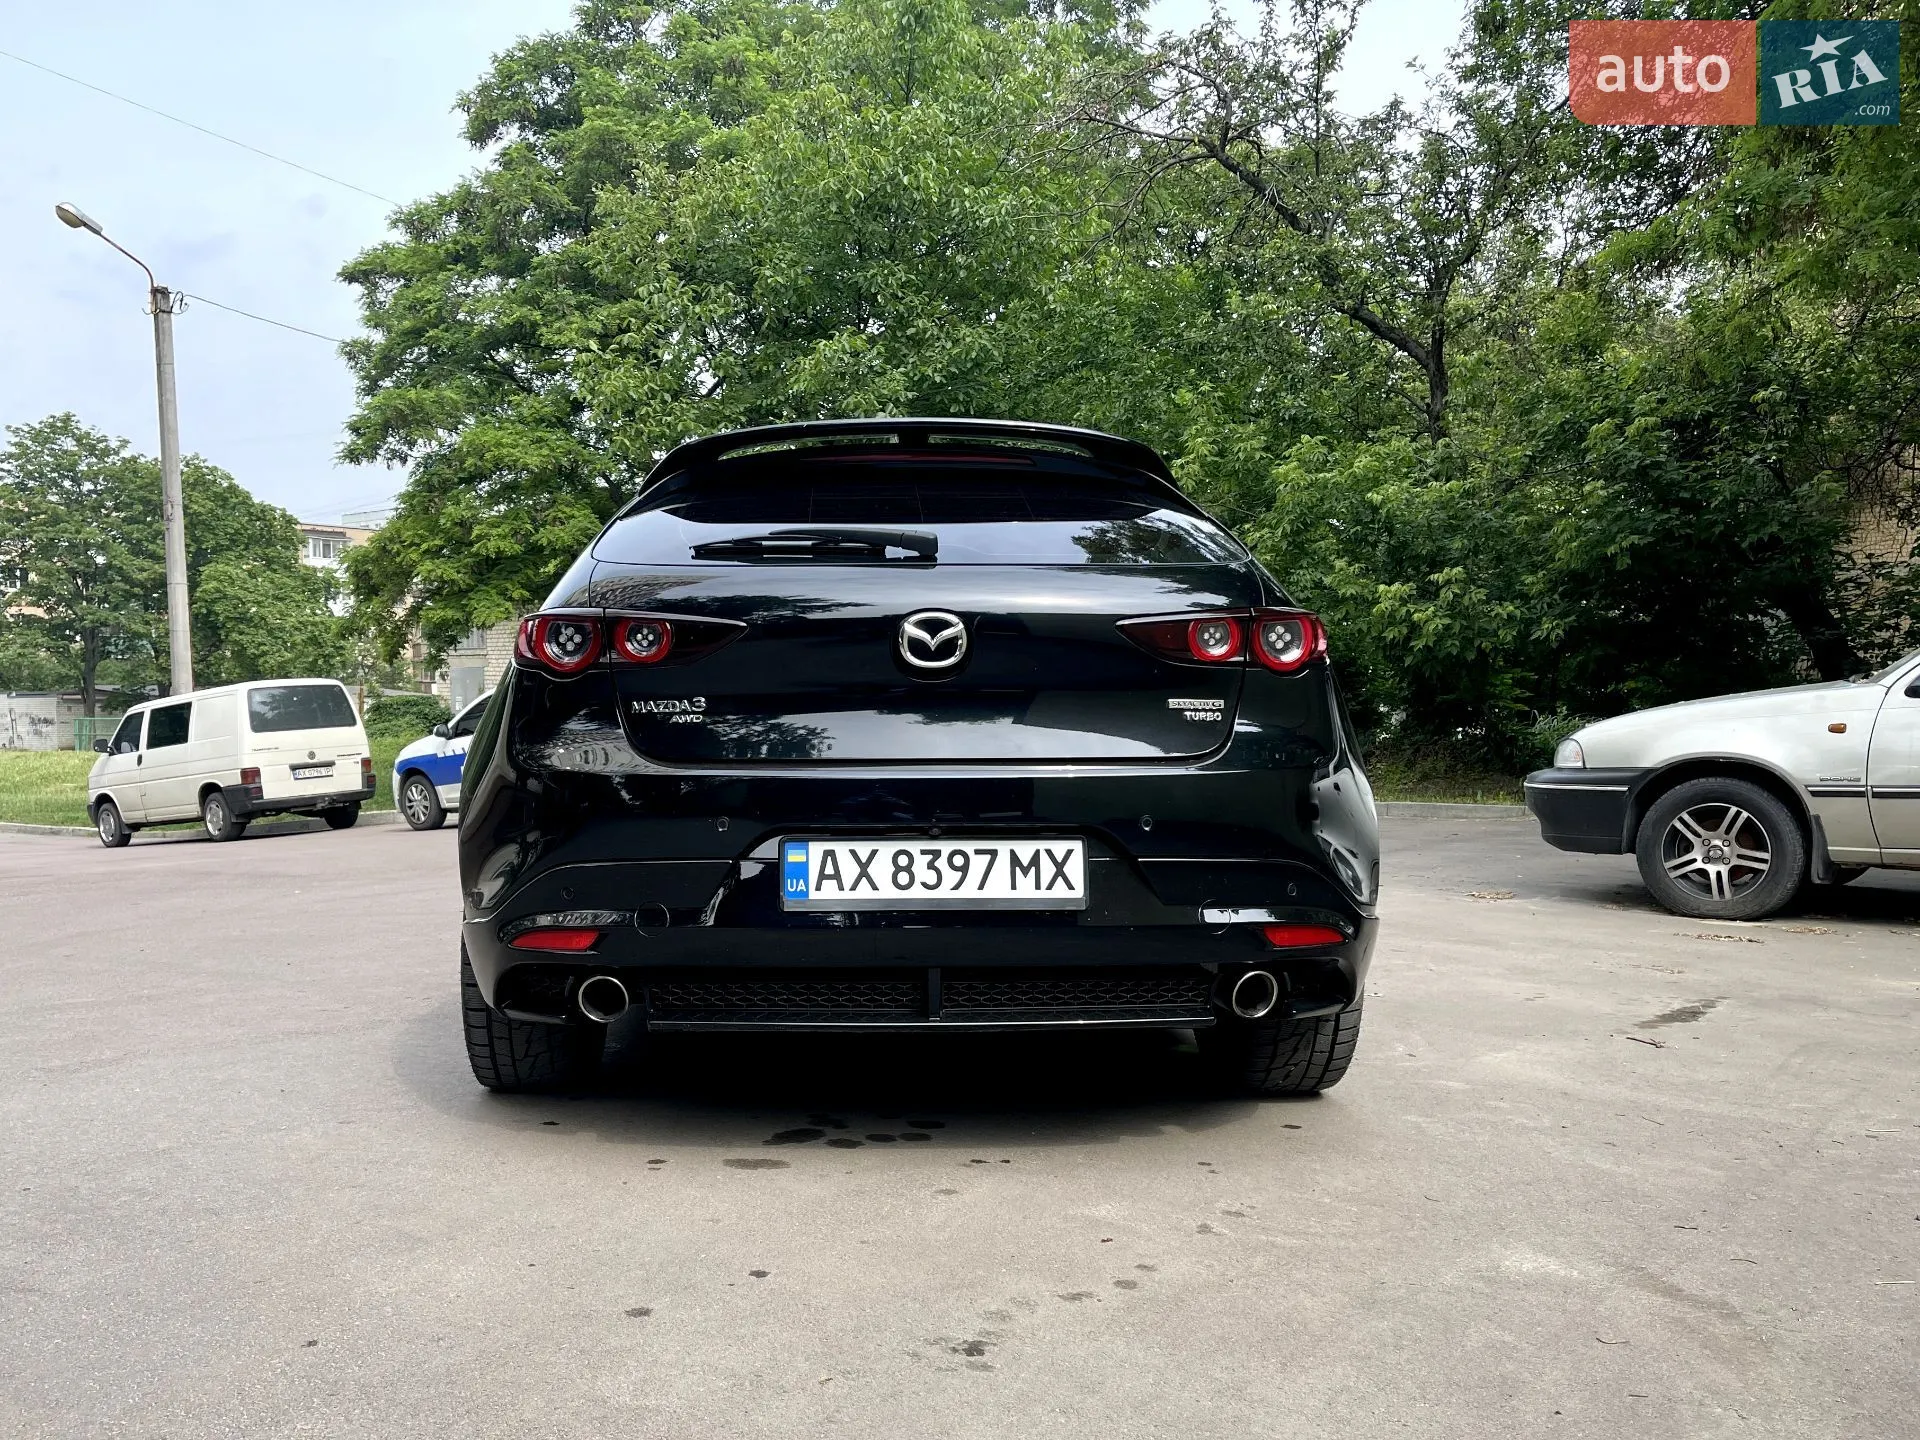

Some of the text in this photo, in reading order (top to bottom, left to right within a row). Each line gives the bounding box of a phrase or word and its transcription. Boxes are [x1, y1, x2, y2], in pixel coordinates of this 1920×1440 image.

[669, 714, 703, 723] AWD
[1183, 711, 1222, 721] TURBO
[814, 848, 1075, 891] AX 8397 MX
[787, 879, 807, 892] UA
